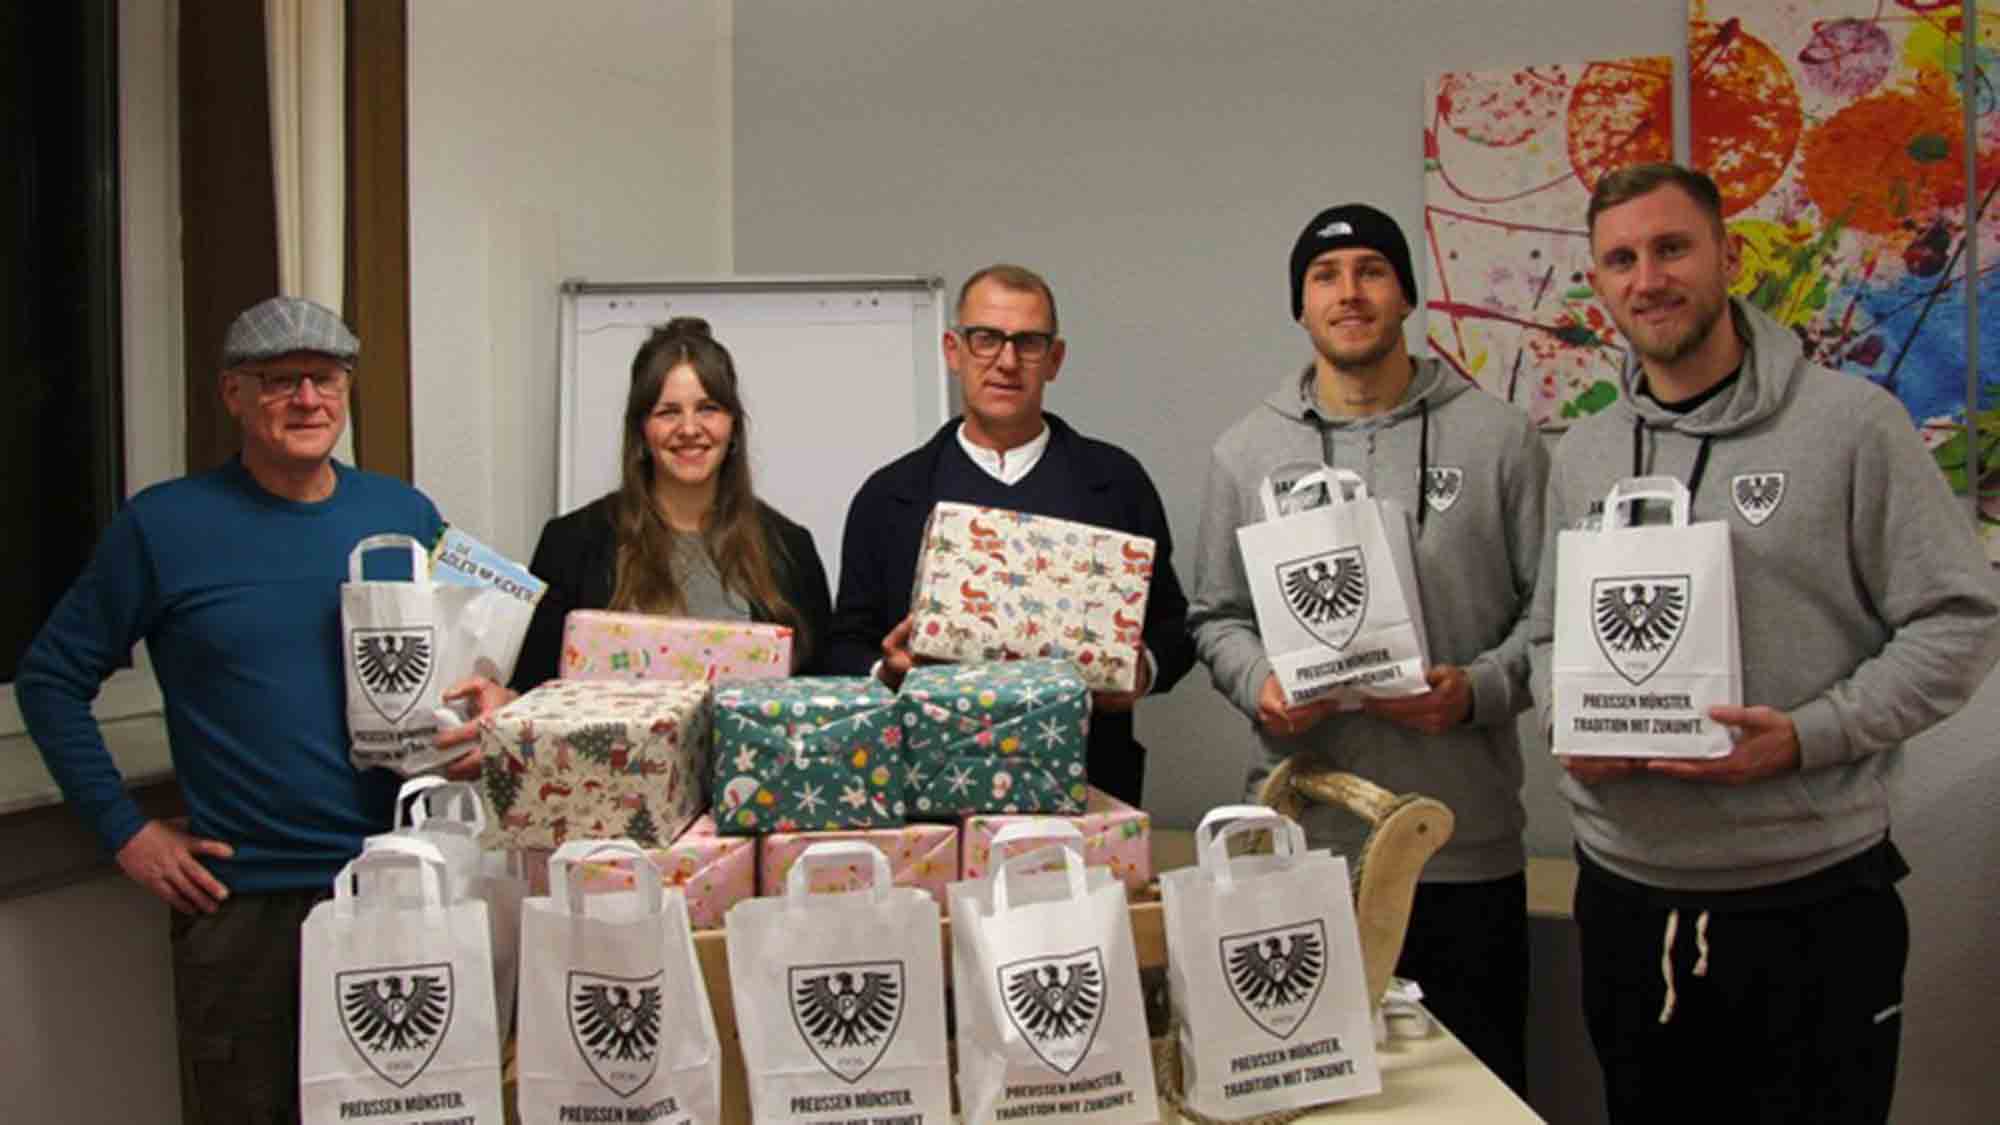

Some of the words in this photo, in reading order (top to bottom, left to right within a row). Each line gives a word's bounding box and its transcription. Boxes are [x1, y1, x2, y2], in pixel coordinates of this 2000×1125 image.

[1583, 693, 1636, 709] PREUSSEN
[1573, 717, 1628, 733] TRADITION
[1631, 718, 1650, 733] MIT
[1230, 1048, 1286, 1073] PREUSSEN
[1005, 1082, 1067, 1101] PREUSSEN
[1223, 1074, 1280, 1099] TRADITION
[1281, 1068, 1303, 1087] MIT
[340, 1098, 402, 1119] PREUSSEN
[790, 1095, 851, 1113] PREUSSEN
[996, 1102, 1056, 1121] TRADITION
[1057, 1100, 1081, 1114] MIT
[560, 1106, 624, 1122] PREUSSEN
